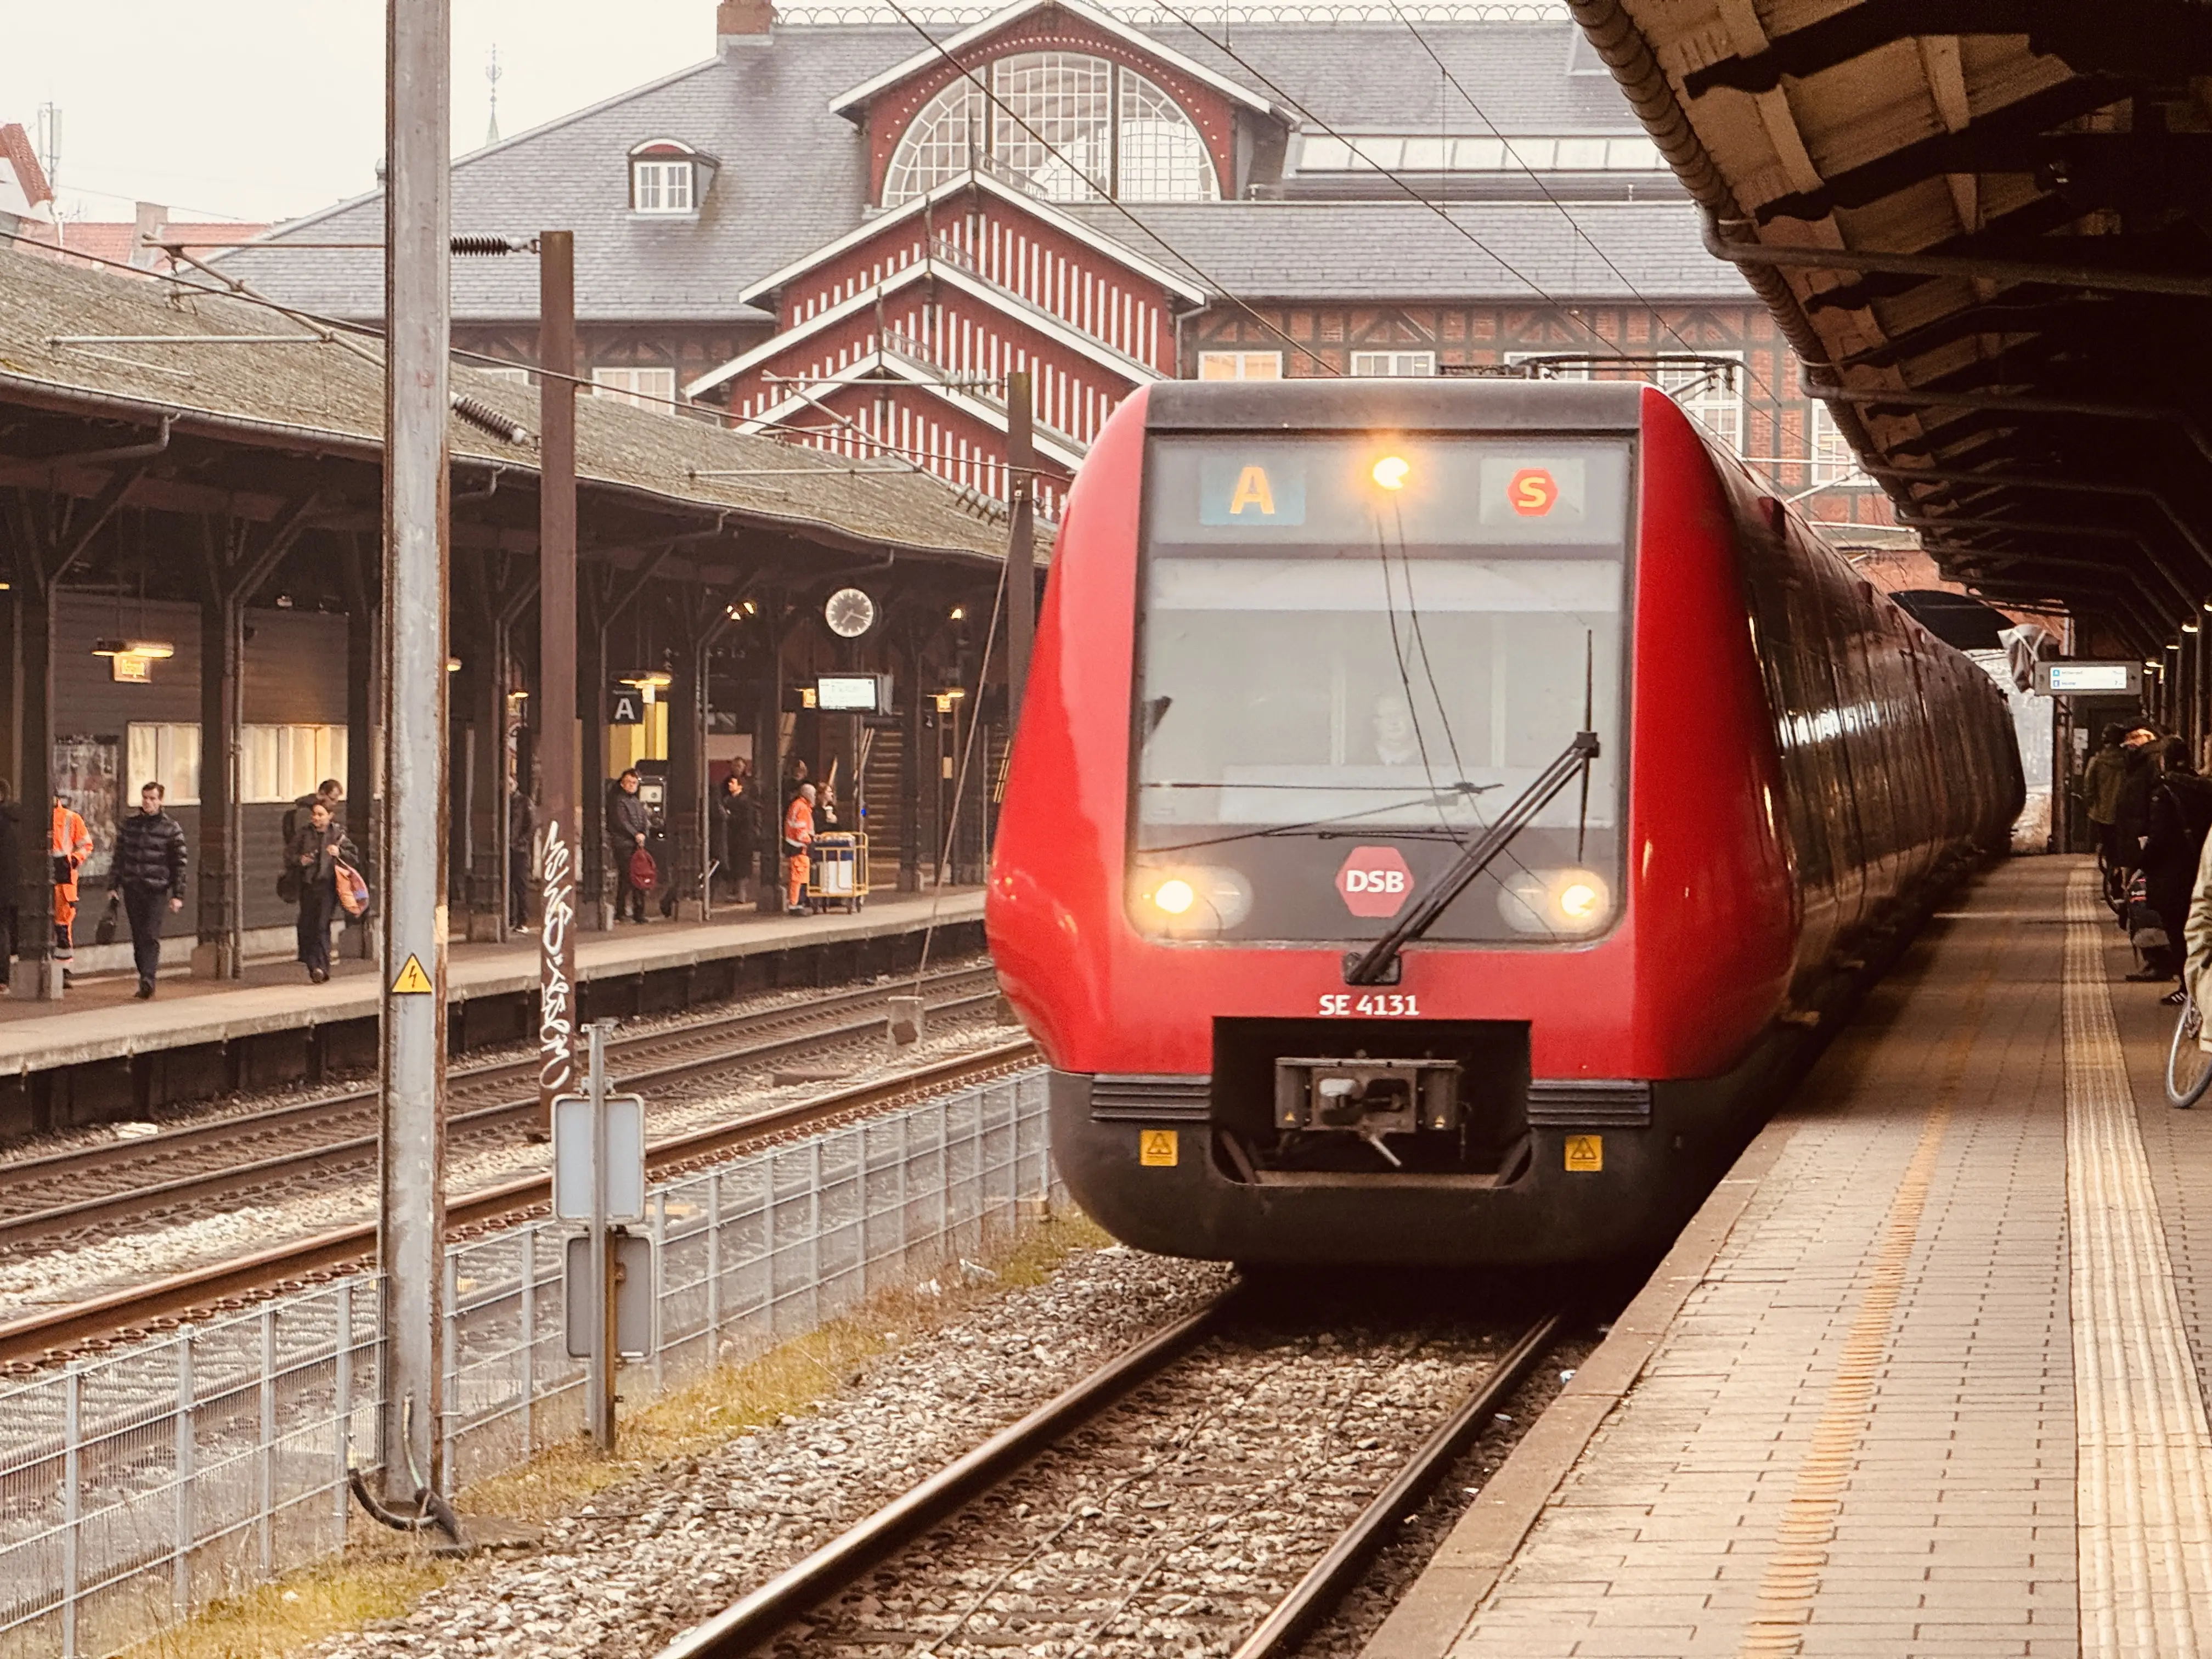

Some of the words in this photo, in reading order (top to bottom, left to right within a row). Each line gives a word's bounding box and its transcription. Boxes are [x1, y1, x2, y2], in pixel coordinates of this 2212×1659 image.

[1229, 466, 1275, 514] A
[1518, 477, 1547, 507] S
[614, 697, 635, 720] A
[1346, 870, 1404, 893] DSB
[1319, 994, 1351, 1015] SE
[1356, 995, 1420, 1015] 4131
